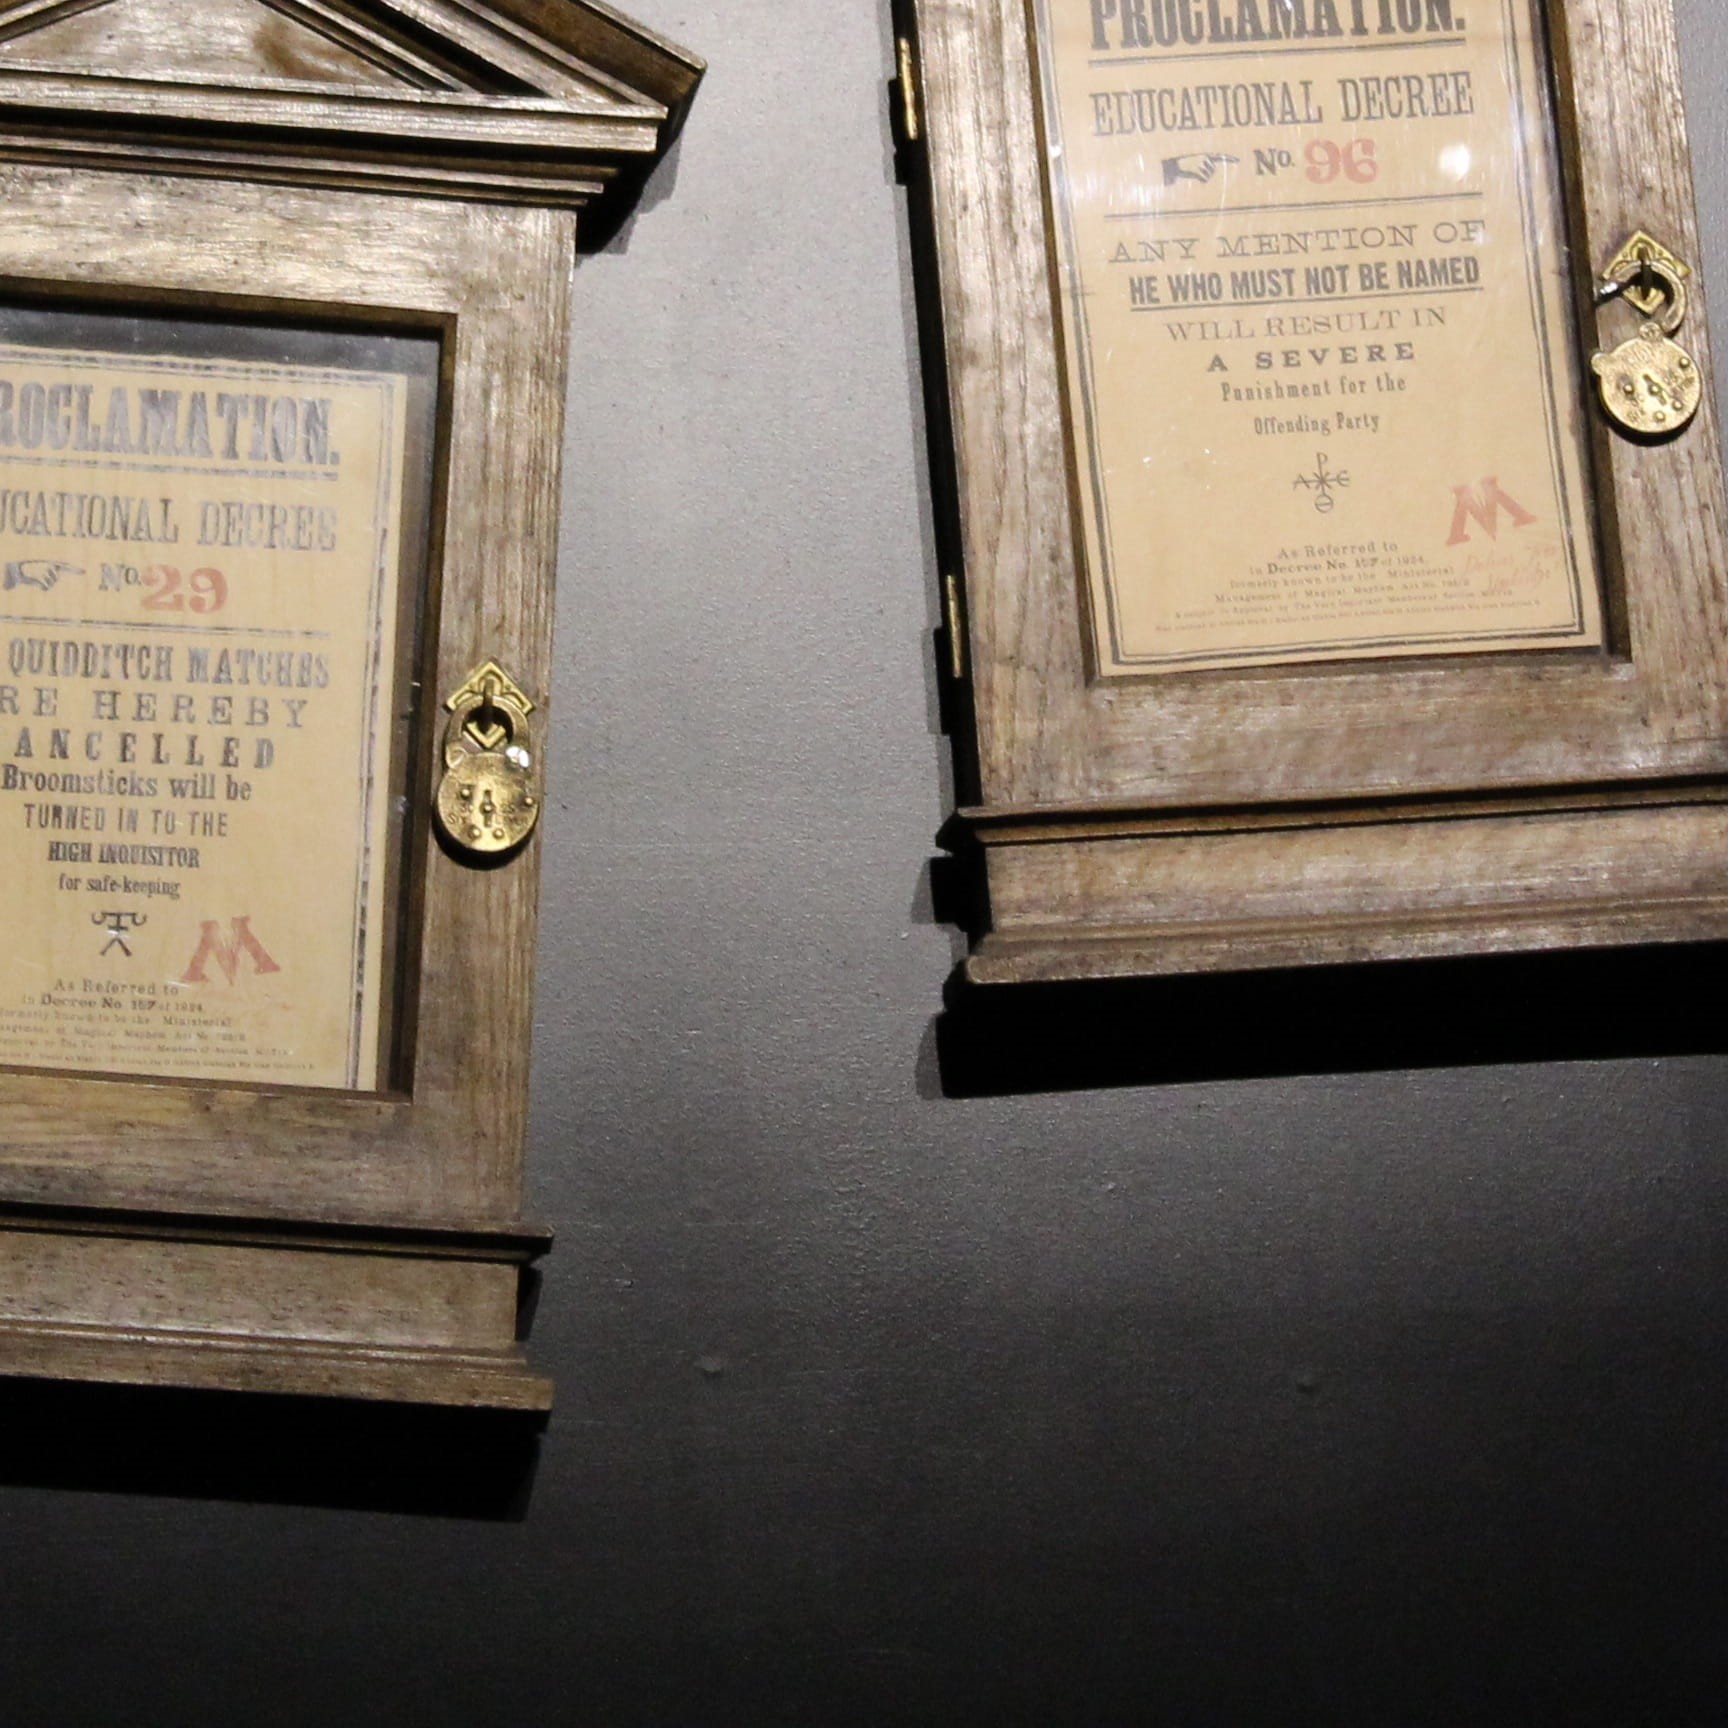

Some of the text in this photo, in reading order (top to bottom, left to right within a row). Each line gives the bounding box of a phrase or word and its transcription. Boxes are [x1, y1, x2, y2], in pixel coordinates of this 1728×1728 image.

[1089, 70, 1474, 138] EDUCATIONAL DECREE
[1302, 138, 1380, 185] 96
[1109, 218, 1487, 265] ANY MENTION OF
[1129, 255, 1481, 306] HE WHO MUST NOT BE NAMED
[1164, 306, 1448, 343] WILL RESULT IN
[1206, 341, 1416, 373] A SEVERE
[1220, 373, 1407, 404] Punishment for the
[1252, 412, 1380, 436] Offending Party
[197, 501, 338, 552] DECREE
[140, 563, 228, 615] 29
[8, 637, 172, 682] QUIDDITCH
[186, 646, 330, 690] MATCHES
[92, 689, 310, 729] HEREBY
[0, 763, 253, 802] Broomsticks will be
[24, 803, 229, 837] TURNED IN TO THE
[47, 840, 201, 869] HIGH INQUISITOR
[58, 873, 182, 900] for safe-keeping
